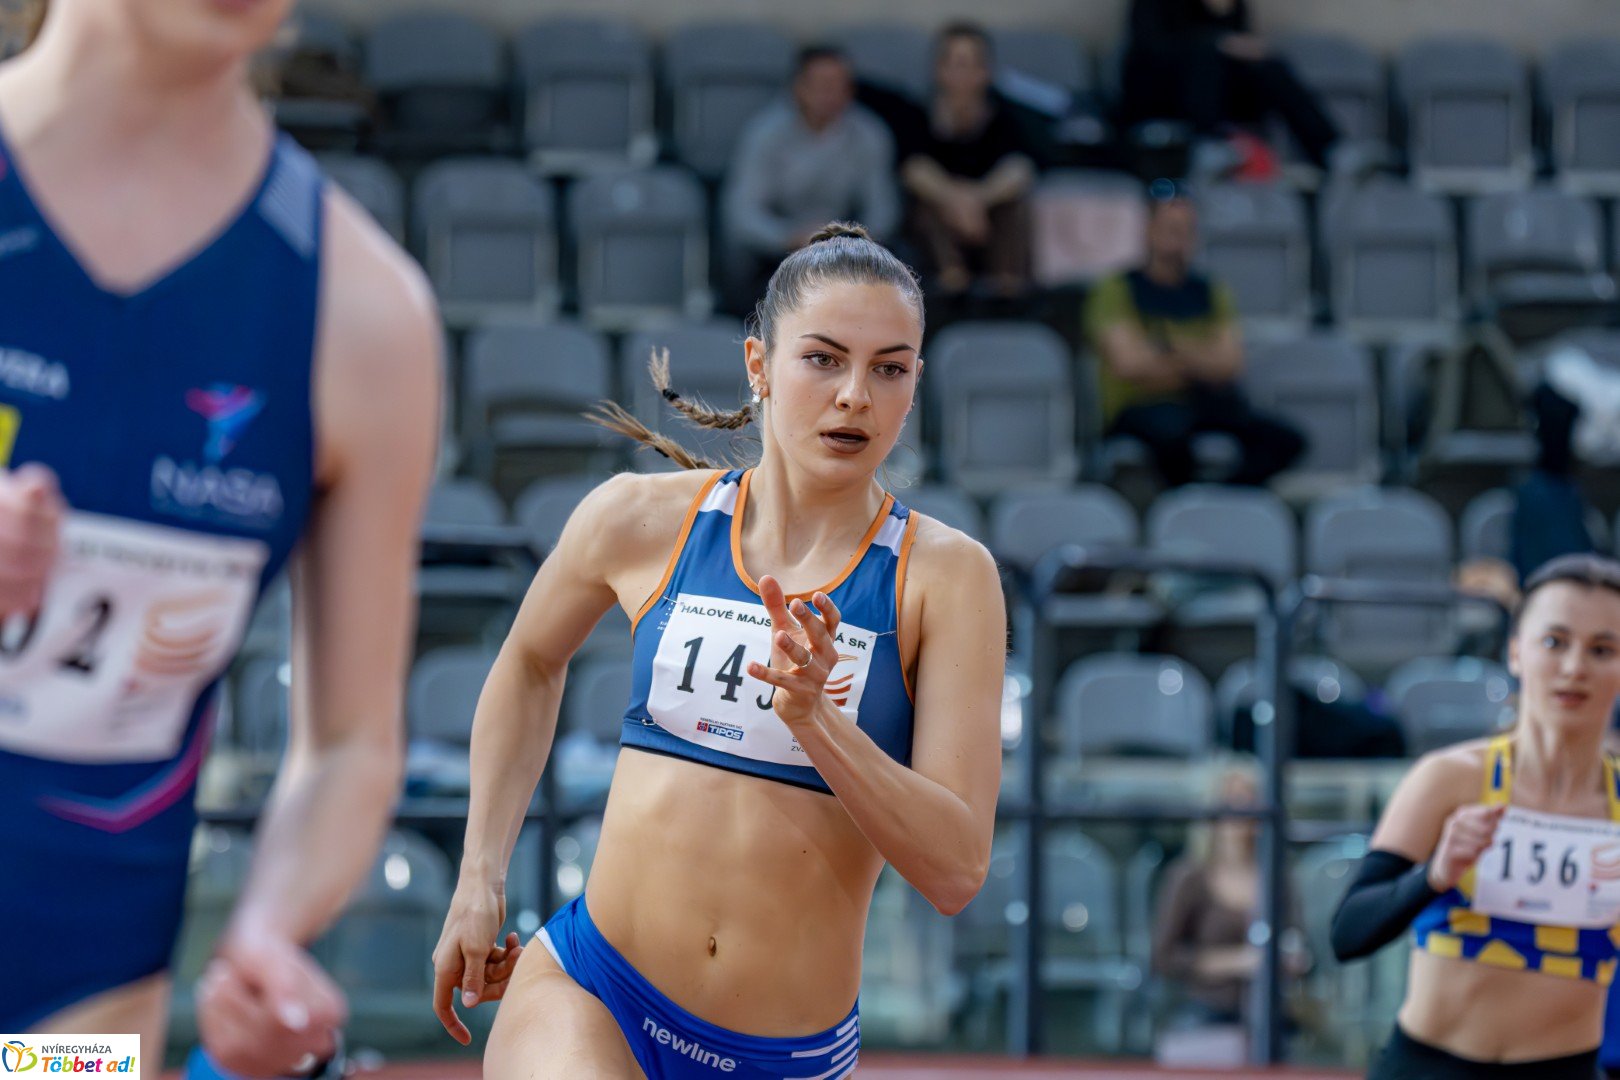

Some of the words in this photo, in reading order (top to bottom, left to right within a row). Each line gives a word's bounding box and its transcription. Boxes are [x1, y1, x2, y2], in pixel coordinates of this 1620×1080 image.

[150, 454, 283, 519] NASA
[680, 604, 734, 620] HALOVÉ
[848, 637, 867, 650] SR
[710, 726, 743, 740] TIPOS
[1500, 837, 1579, 890] 156
[642, 1016, 736, 1072] newline
